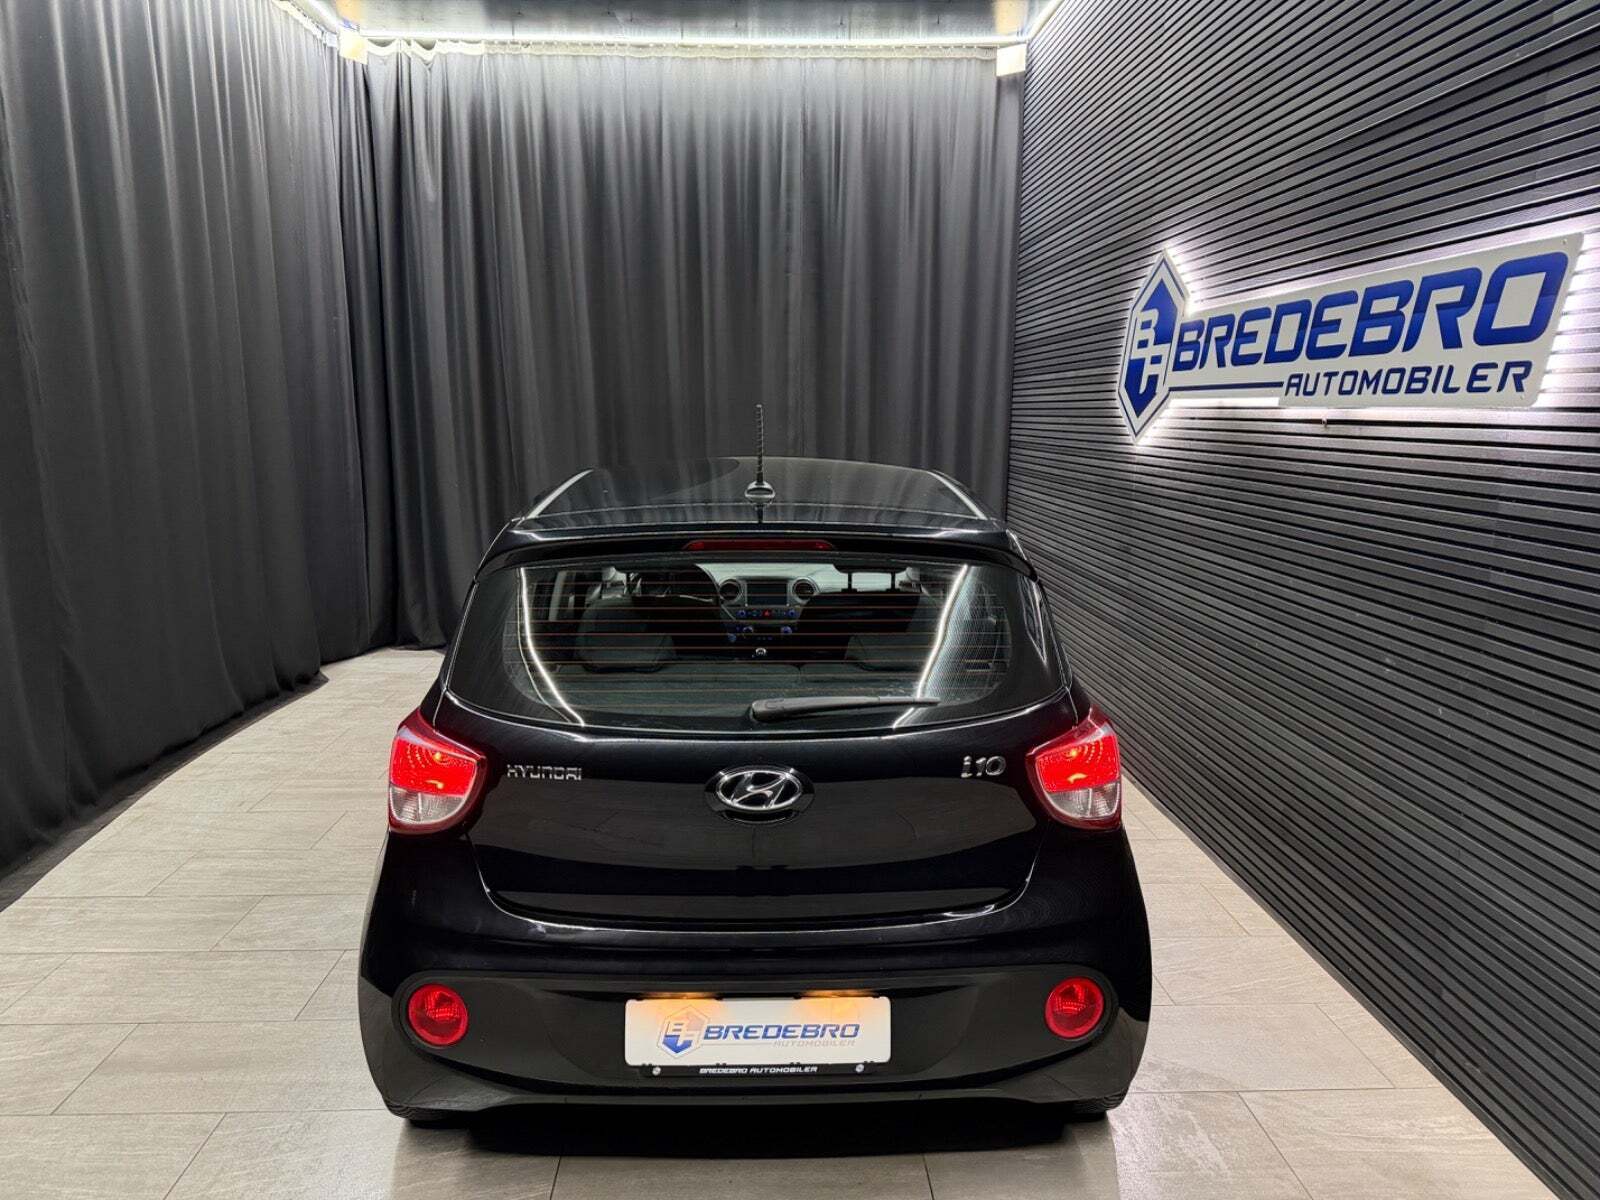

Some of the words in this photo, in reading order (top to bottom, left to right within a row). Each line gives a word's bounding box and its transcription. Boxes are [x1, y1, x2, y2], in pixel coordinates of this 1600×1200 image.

[1172, 251, 1569, 372] BREDEBRO
[1284, 360, 1533, 396] AUTOMOBILER
[506, 764, 582, 780] HYUNDAI
[960, 755, 1007, 778] i10
[703, 1023, 860, 1040] BREDEBRO
[772, 1039, 856, 1047] AUTOMOBILER
